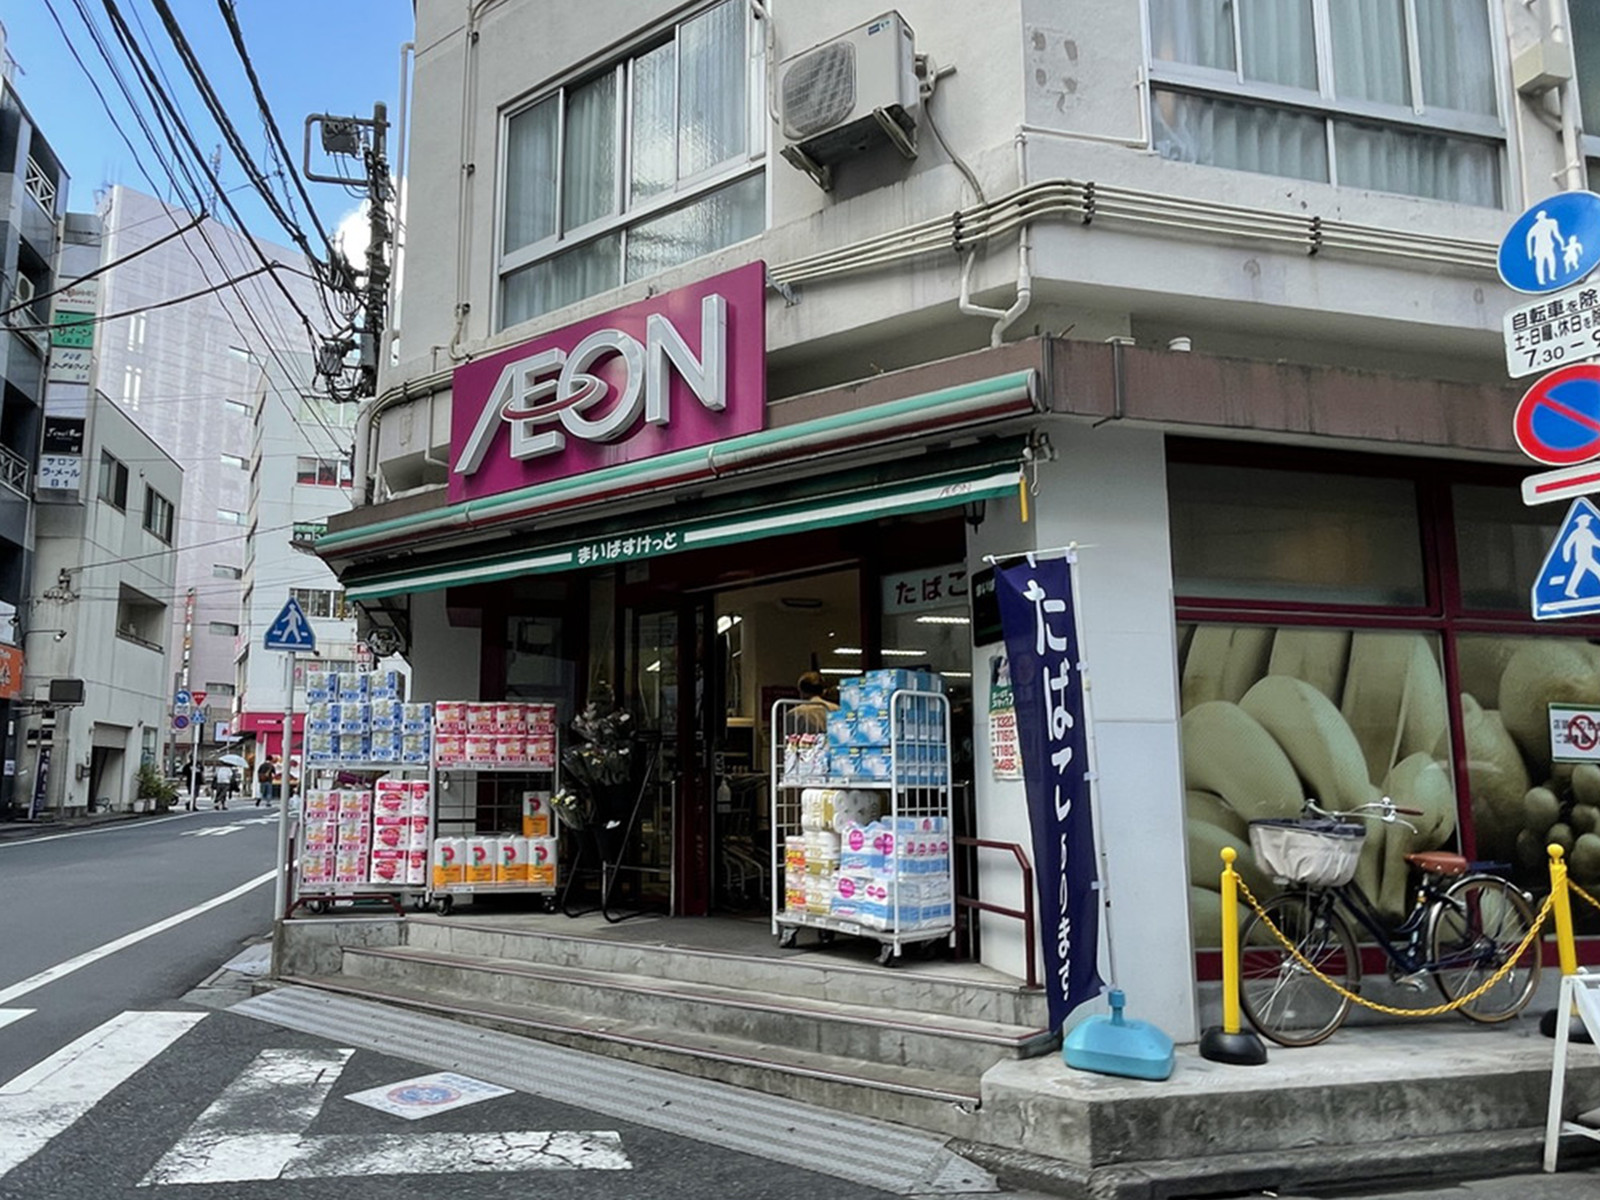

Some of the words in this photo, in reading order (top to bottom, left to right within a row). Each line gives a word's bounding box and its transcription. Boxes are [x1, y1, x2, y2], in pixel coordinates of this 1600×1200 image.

[42, 467, 80, 478] ラ・メール
[47, 458, 77, 466] サロン
[577, 532, 678, 564] まいばすけっと
[895, 571, 968, 605] たばこ
